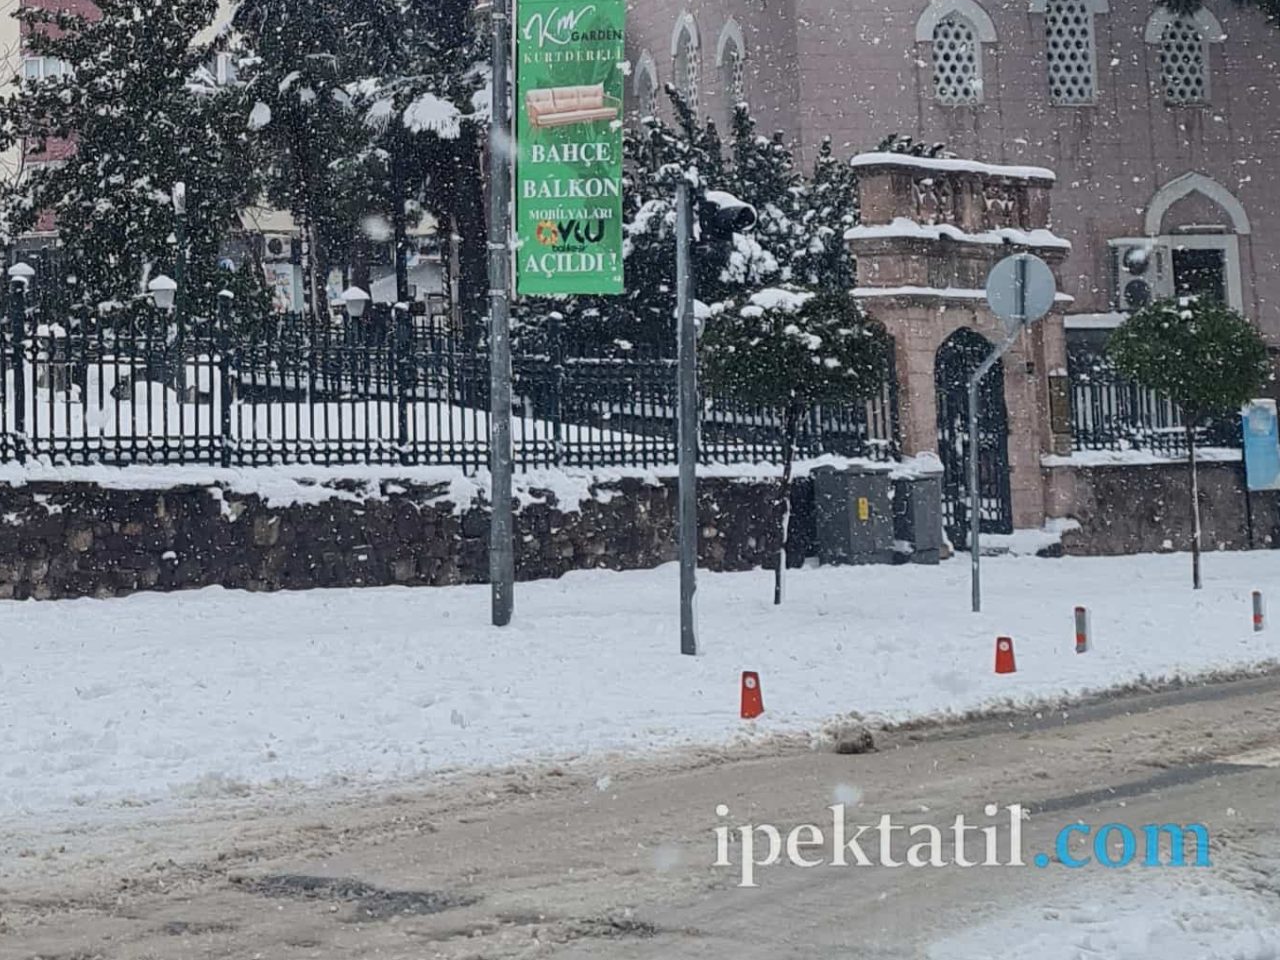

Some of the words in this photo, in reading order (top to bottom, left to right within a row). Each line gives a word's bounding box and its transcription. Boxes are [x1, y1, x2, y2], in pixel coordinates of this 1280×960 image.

[571, 30, 622, 42] GARDEN
[532, 142, 611, 166] BAHÇE
[523, 178, 620, 199] BALKON
[529, 208, 613, 220] MOBİLYALARI
